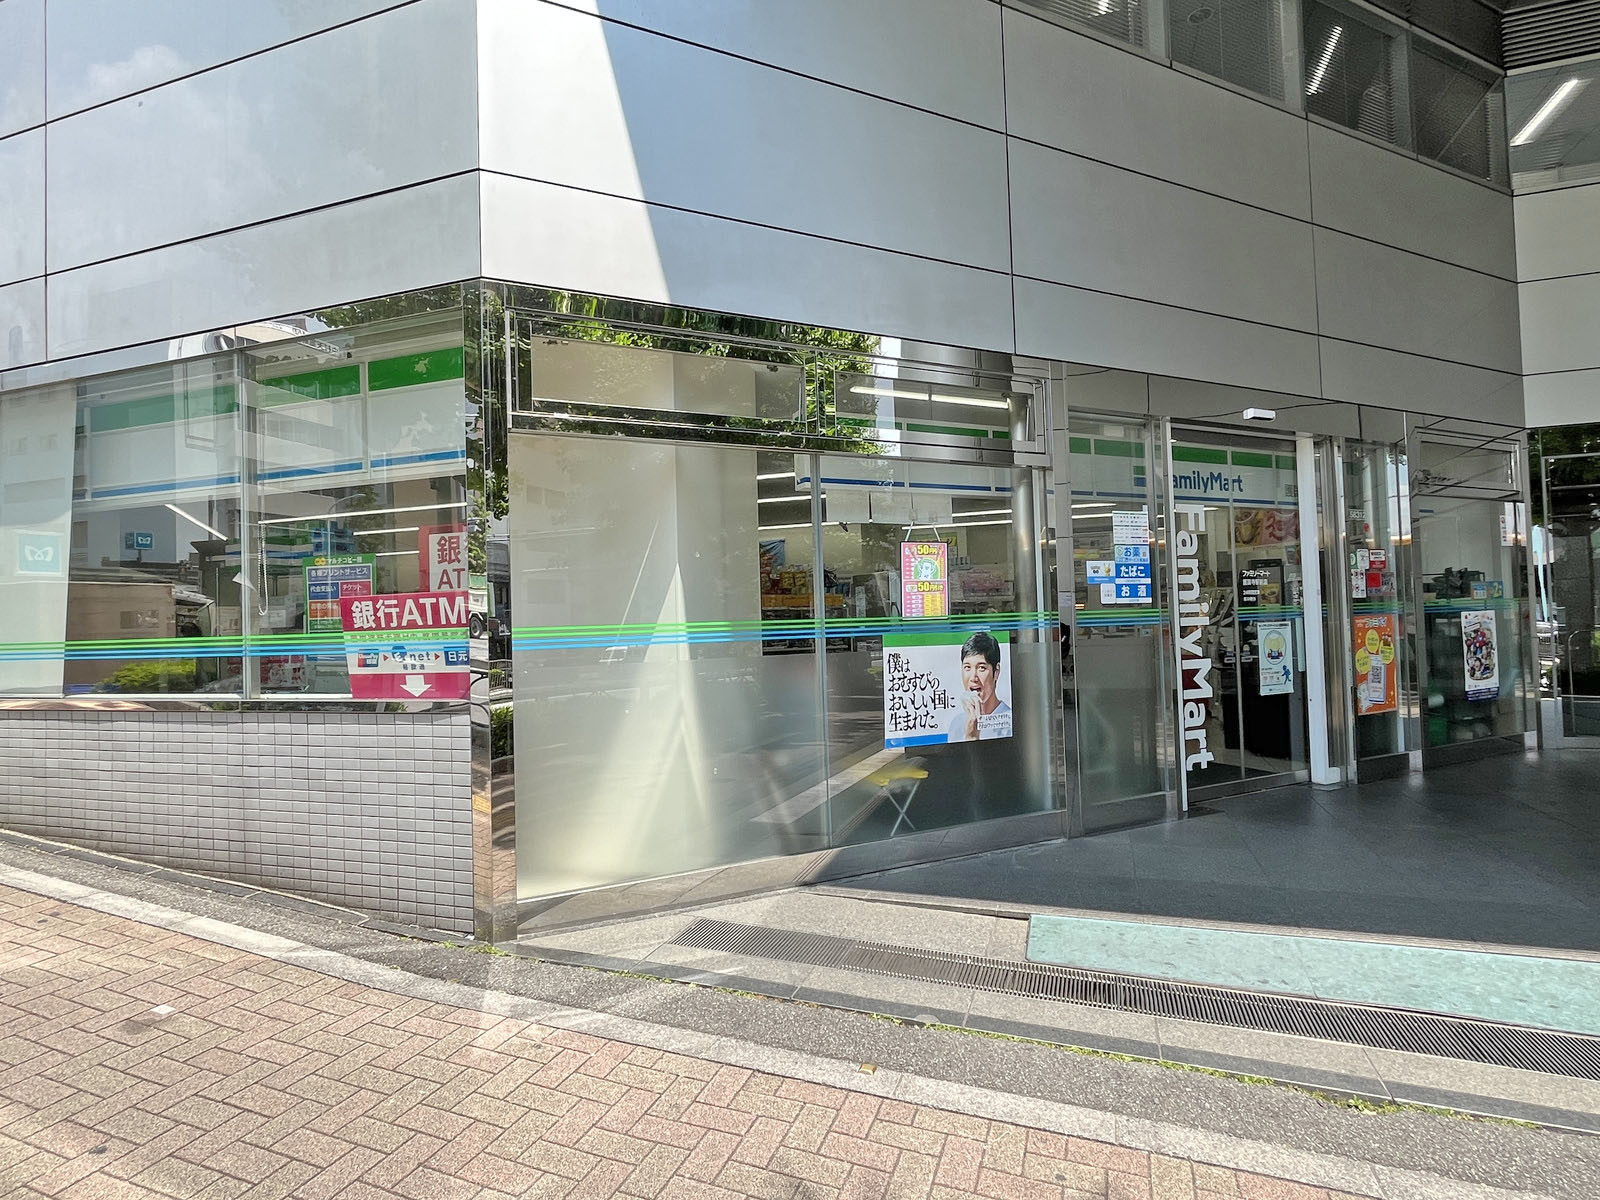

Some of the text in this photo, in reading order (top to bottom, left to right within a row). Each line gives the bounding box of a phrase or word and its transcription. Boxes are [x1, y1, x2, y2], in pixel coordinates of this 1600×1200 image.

[1173, 471, 1244, 493] amilyMart
[436, 535, 468, 565] 銀
[1120, 565, 1146, 577] たばこ
[351, 596, 467, 629] 銀行ATM
[1175, 503, 1215, 772] FamilyMart
[887, 653, 911, 675] 僕は
[888, 671, 940, 692] おむすびの
[888, 689, 956, 711] おいしい国に
[889, 710, 939, 733] 生まれた。
